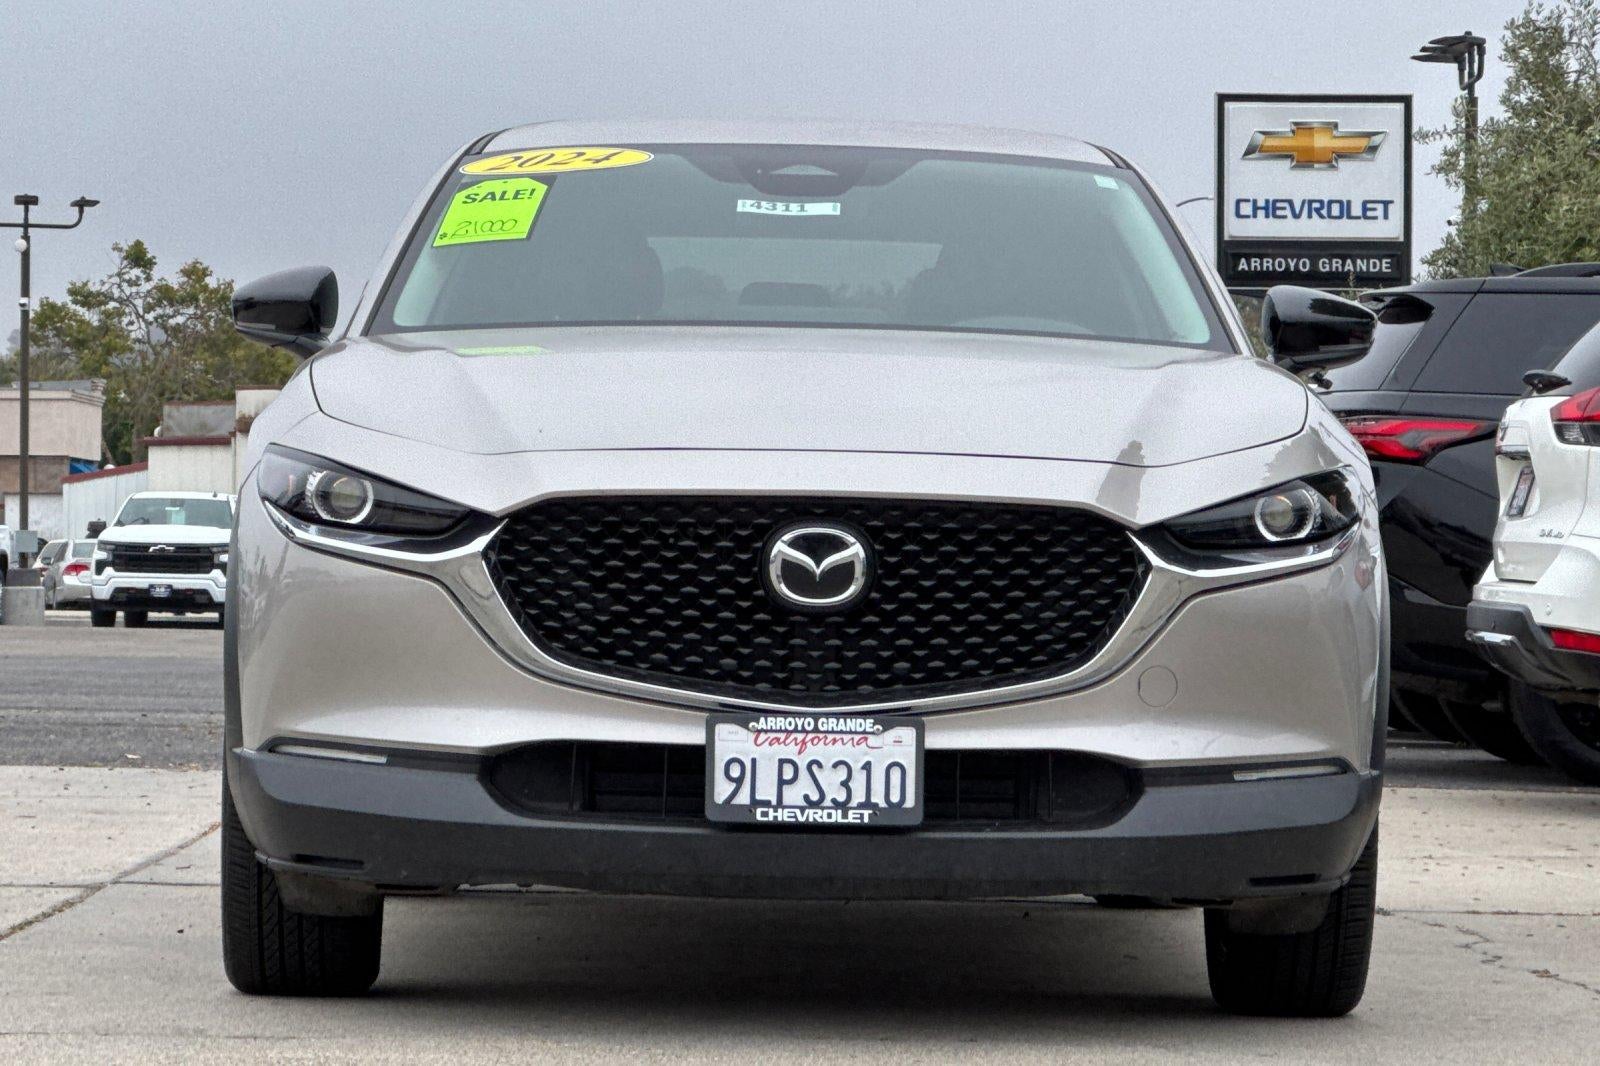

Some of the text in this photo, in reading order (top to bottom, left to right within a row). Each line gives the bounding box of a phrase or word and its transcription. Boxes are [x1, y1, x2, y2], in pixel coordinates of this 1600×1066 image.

[482, 151, 624, 172] 2024
[462, 188, 536, 204] SALE!
[750, 201, 808, 213] 4311
[1234, 198, 1394, 220] CHEVROLET
[1238, 257, 1392, 273] ARROYO GRANDE
[757, 716, 874, 732] ARROYO GRANDE
[753, 731, 884, 756] California
[721, 756, 907, 808] 9LPS310
[755, 807, 873, 823] CHEVROLET
